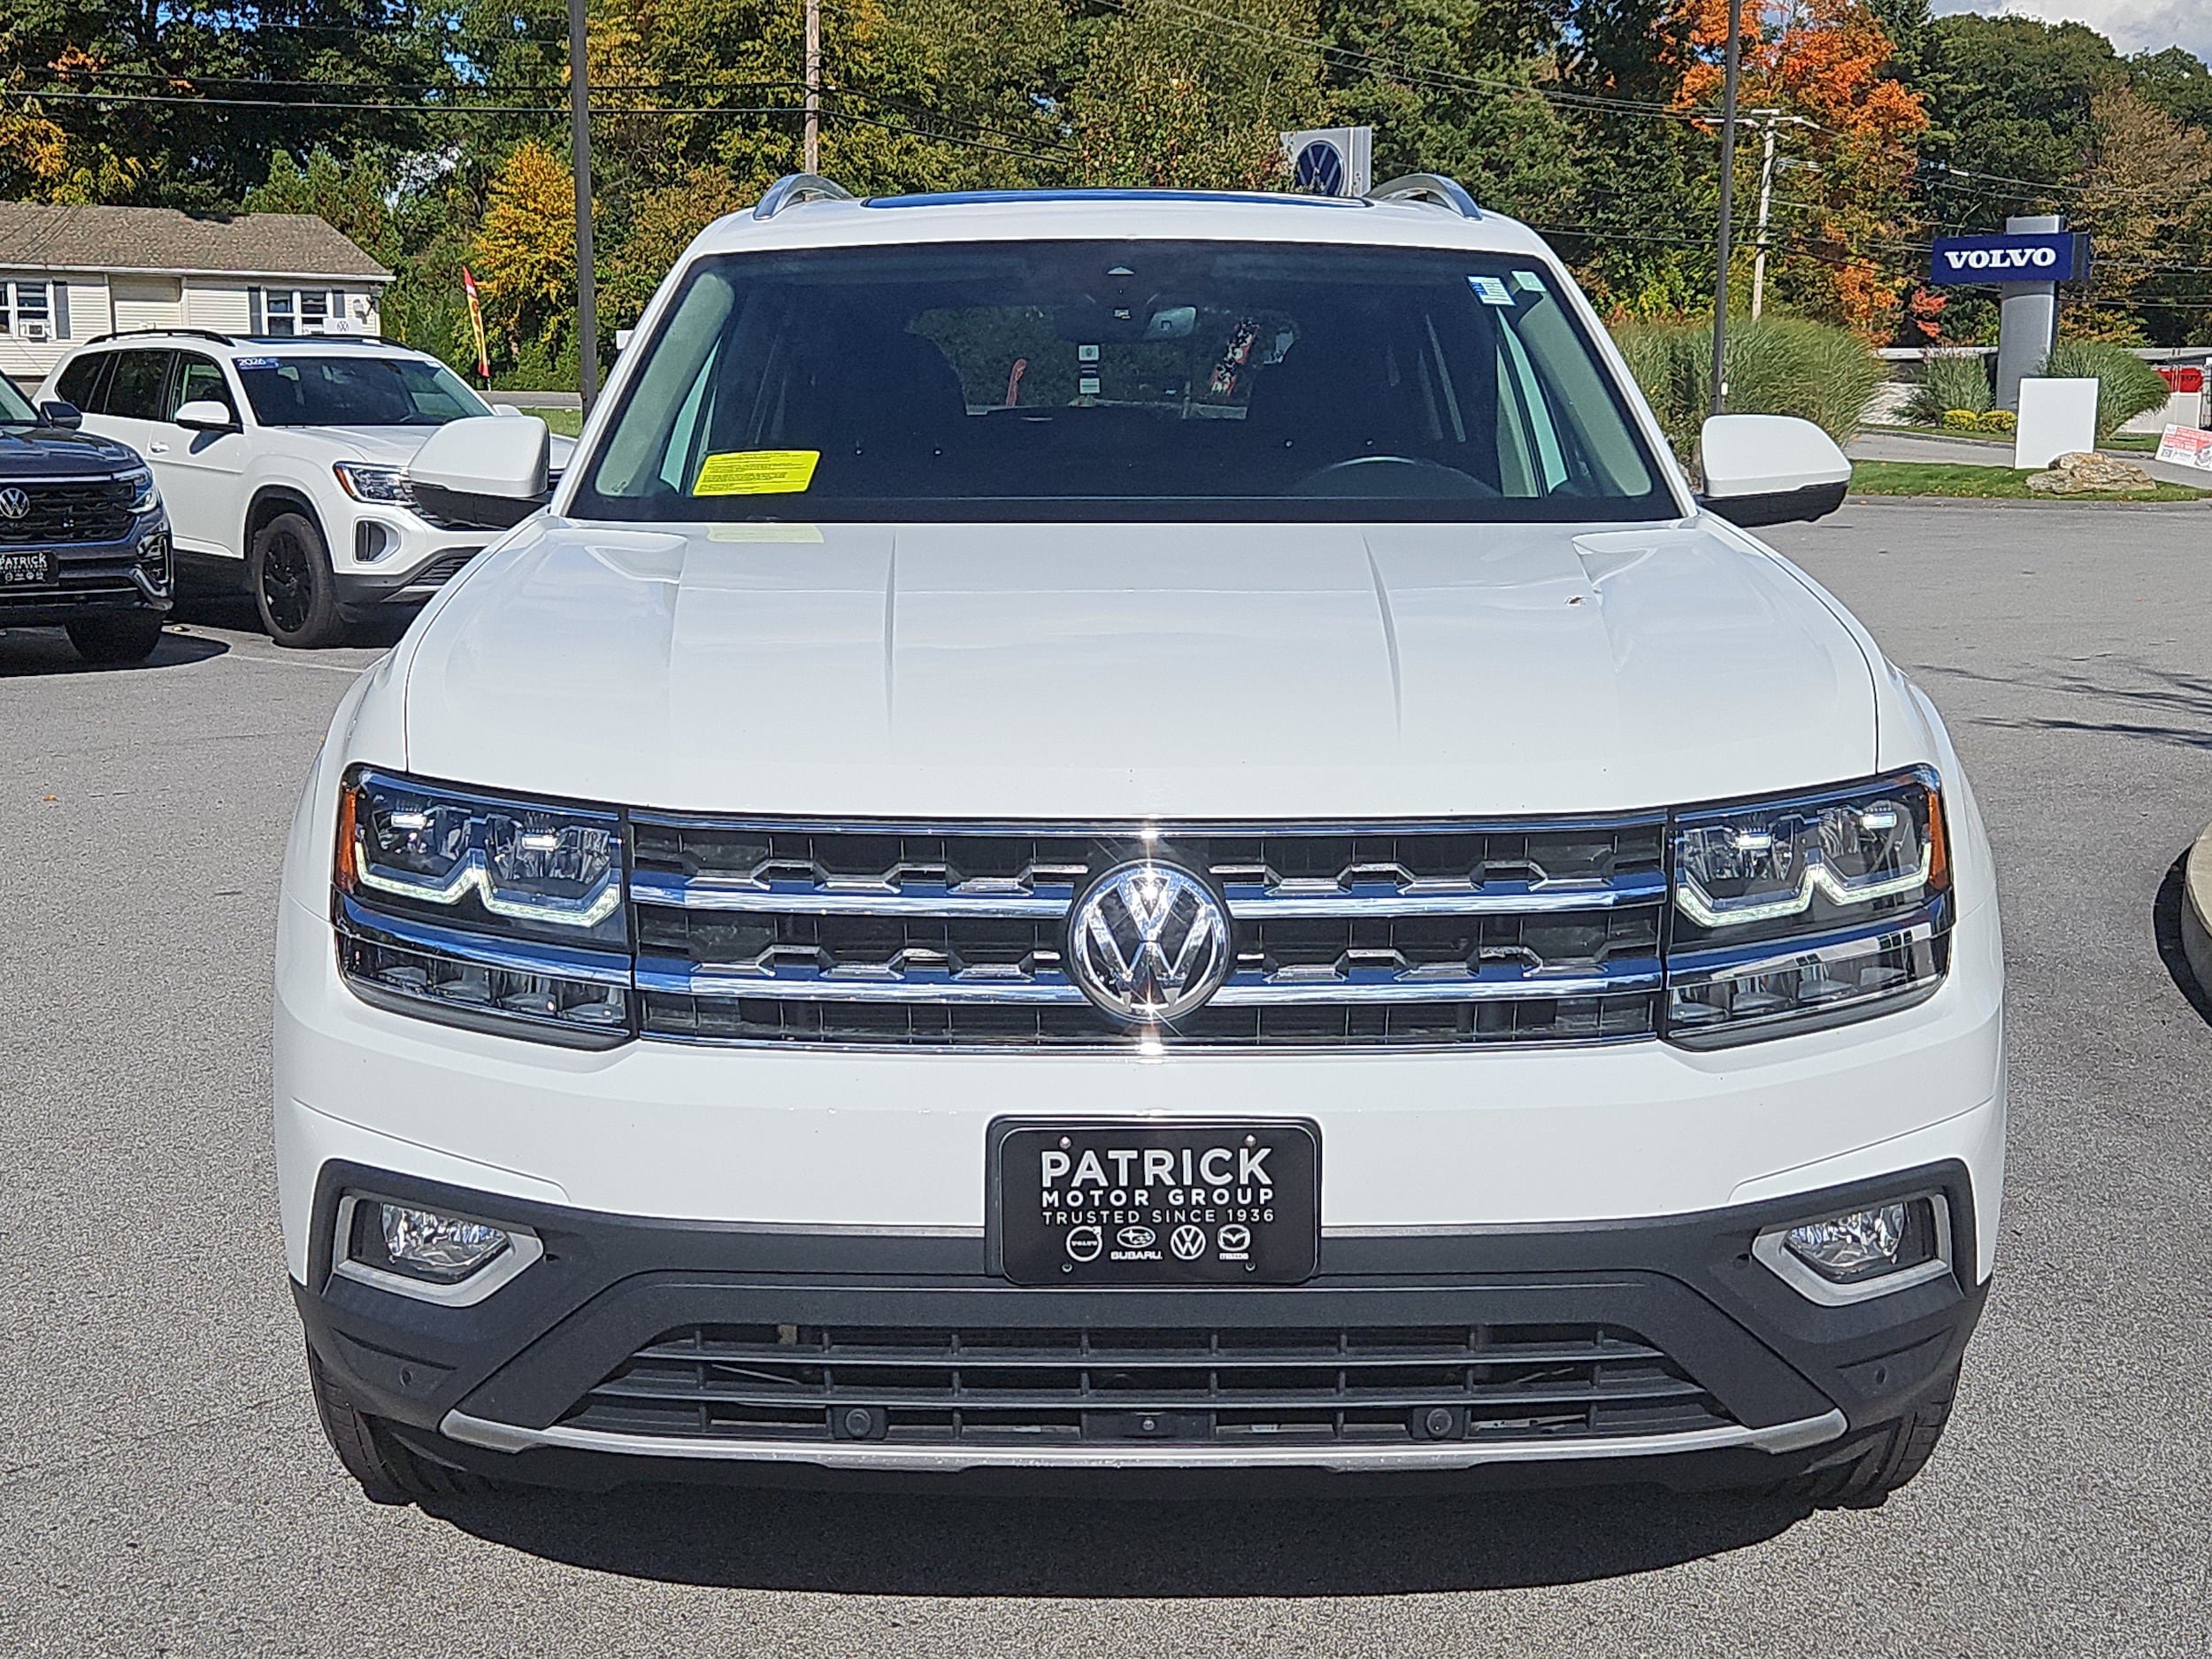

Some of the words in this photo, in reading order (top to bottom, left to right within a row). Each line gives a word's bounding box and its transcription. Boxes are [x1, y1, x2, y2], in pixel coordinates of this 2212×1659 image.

[1945, 248, 2056, 269] VOLVO
[0, 552, 48, 569] PATRICK
[1041, 1148, 1273, 1187] PATRICK
[1041, 1190, 1149, 1208] MOTOR
[1168, 1188, 1274, 1206] GROUP
[1042, 1210, 1141, 1225] TRUSTED
[1151, 1209, 1216, 1223] SINCE
[1226, 1209, 1274, 1223] 1936
[1110, 1251, 1160, 1260] SUBARU
